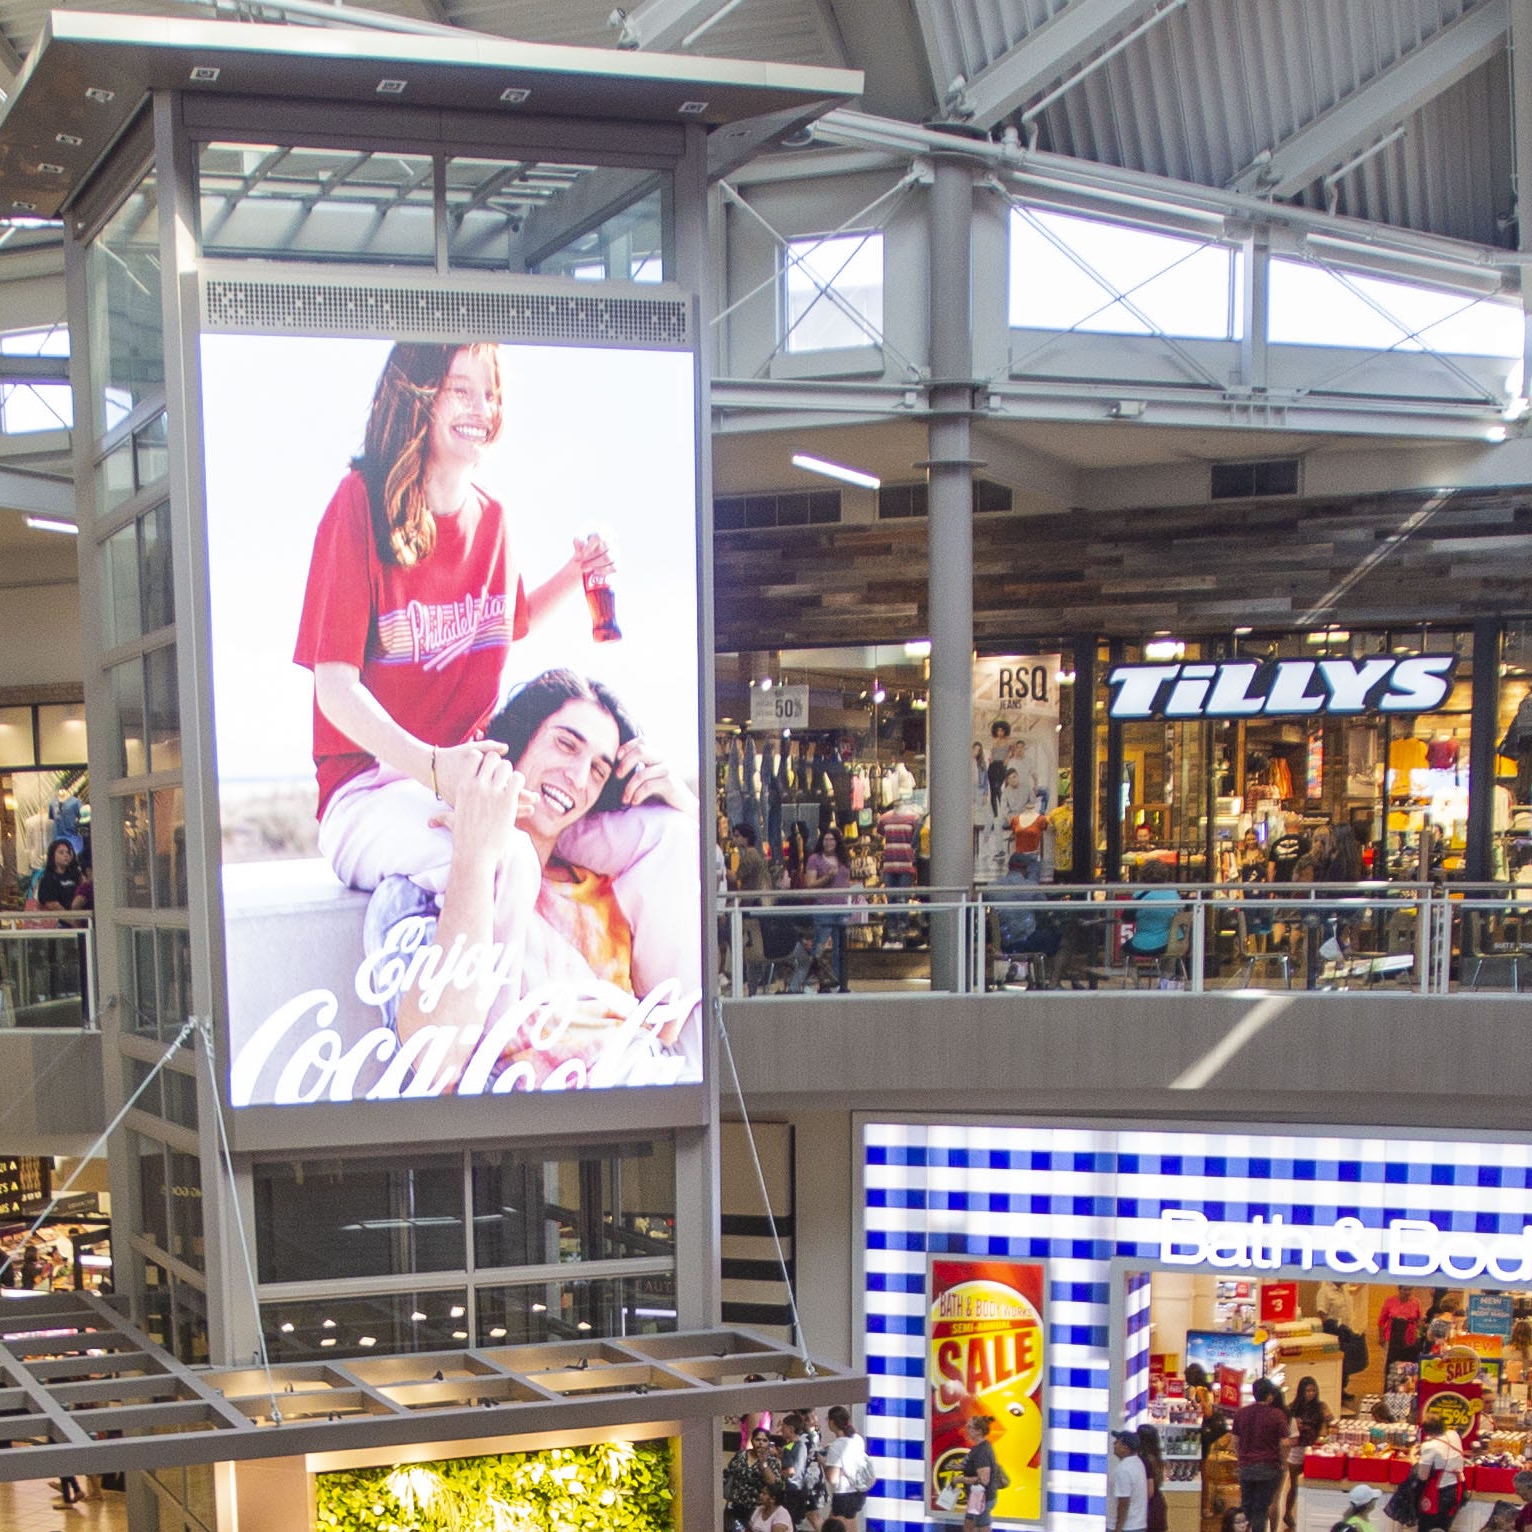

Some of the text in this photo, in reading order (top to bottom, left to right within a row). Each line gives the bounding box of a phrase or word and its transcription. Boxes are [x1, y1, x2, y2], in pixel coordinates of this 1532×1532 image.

[999, 666, 1048, 702] RSQ
[354, 915, 522, 1014] Enjoy
[1159, 1208, 1313, 1271] Bath
[1323, 1215, 1380, 1274] &
[938, 1291, 1033, 1318] BATH & BODY WORKS
[938, 1331, 1036, 1406] SALE
[1447, 1361, 1476, 1380] SALE
